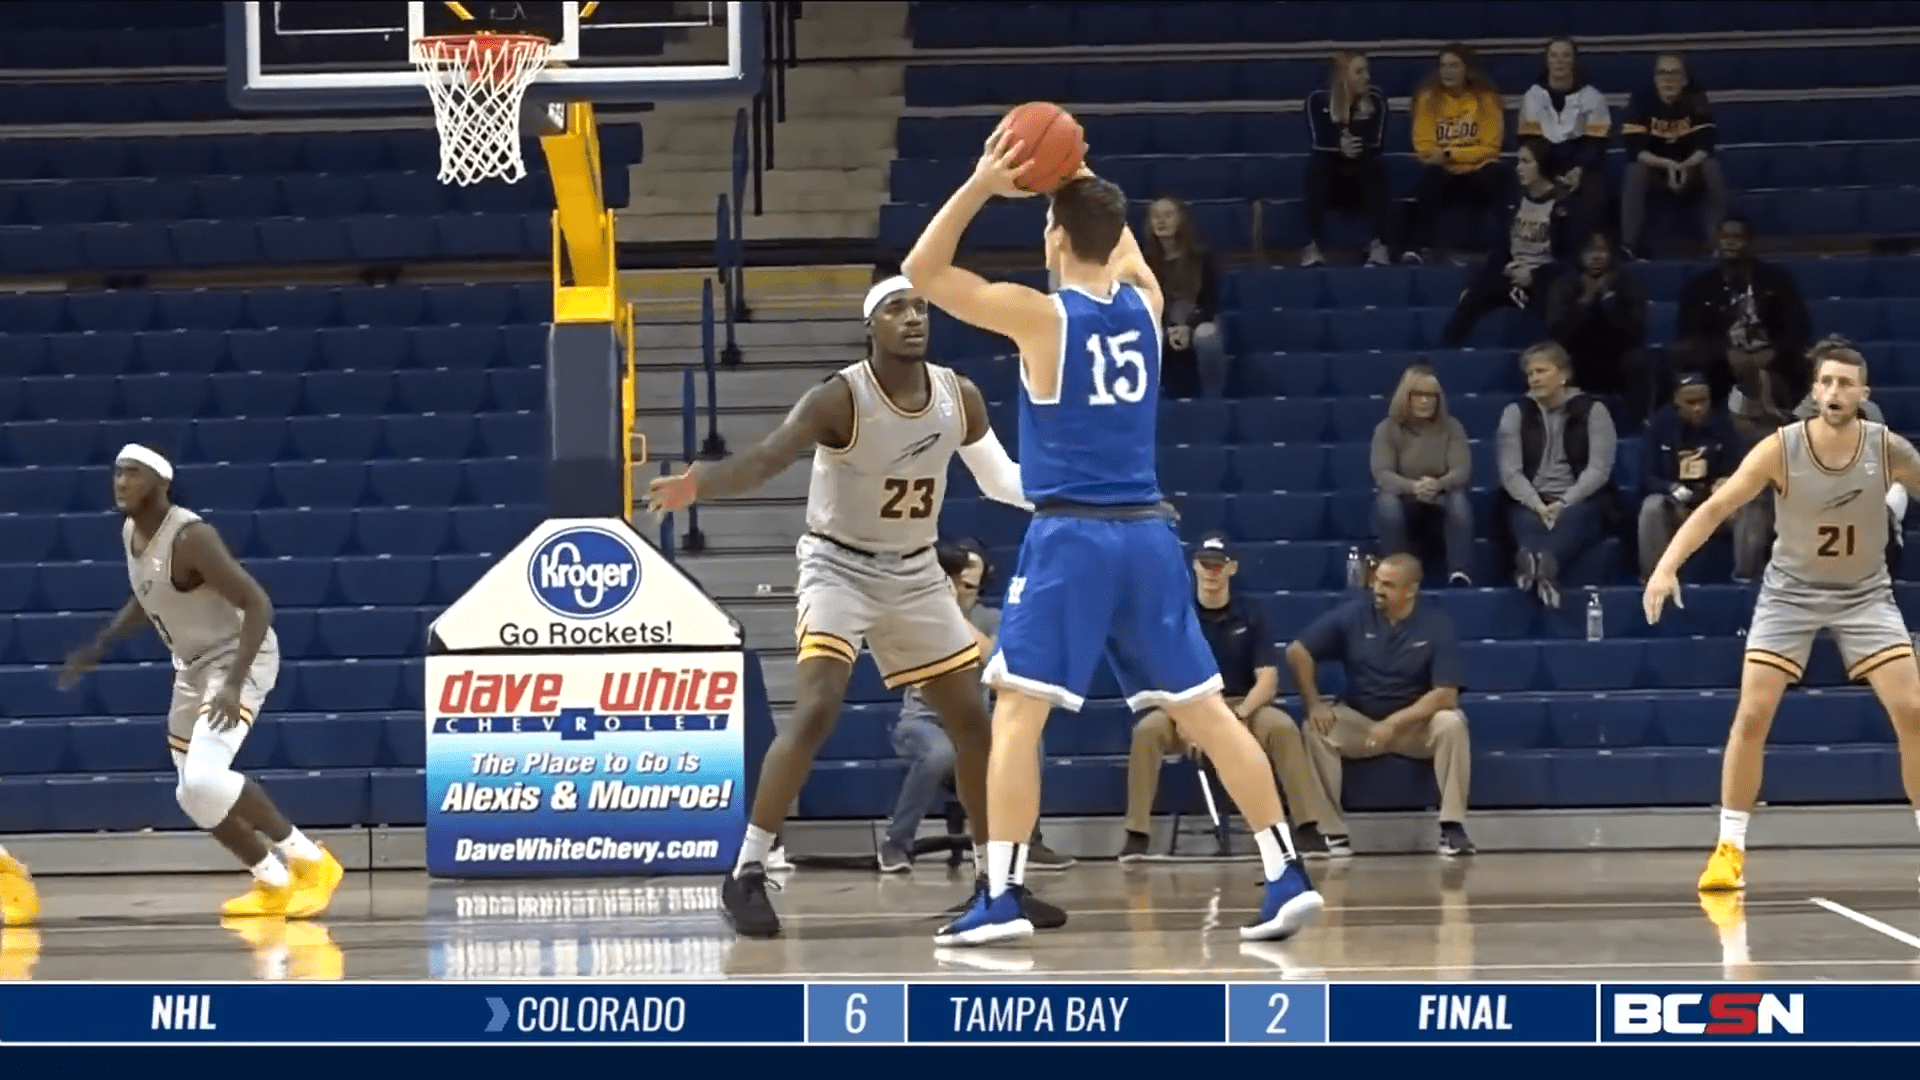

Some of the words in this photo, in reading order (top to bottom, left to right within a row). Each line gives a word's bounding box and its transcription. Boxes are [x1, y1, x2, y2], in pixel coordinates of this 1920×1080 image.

[1086, 330, 1148, 405] 15
[880, 478, 935, 518] 23
[1817, 524, 1855, 557] 21
[541, 541, 633, 608] Kroger
[500, 622, 538, 645] Go
[549, 620, 673, 644] Rockets!
[438, 670, 564, 714] dave
[599, 667, 738, 712] white
[445, 717, 720, 732] CHEVROLET
[472, 752, 515, 774] The
[523, 752, 596, 774] Place
[604, 752, 629, 772] to
[636, 751, 668, 772] Go
[677, 750, 700, 772] is
[440, 781, 541, 812] Alexis
[551, 779, 578, 811] &
[587, 778, 734, 810] Monroe!
[455, 837, 719, 864] DaveWhiteChevy.com
